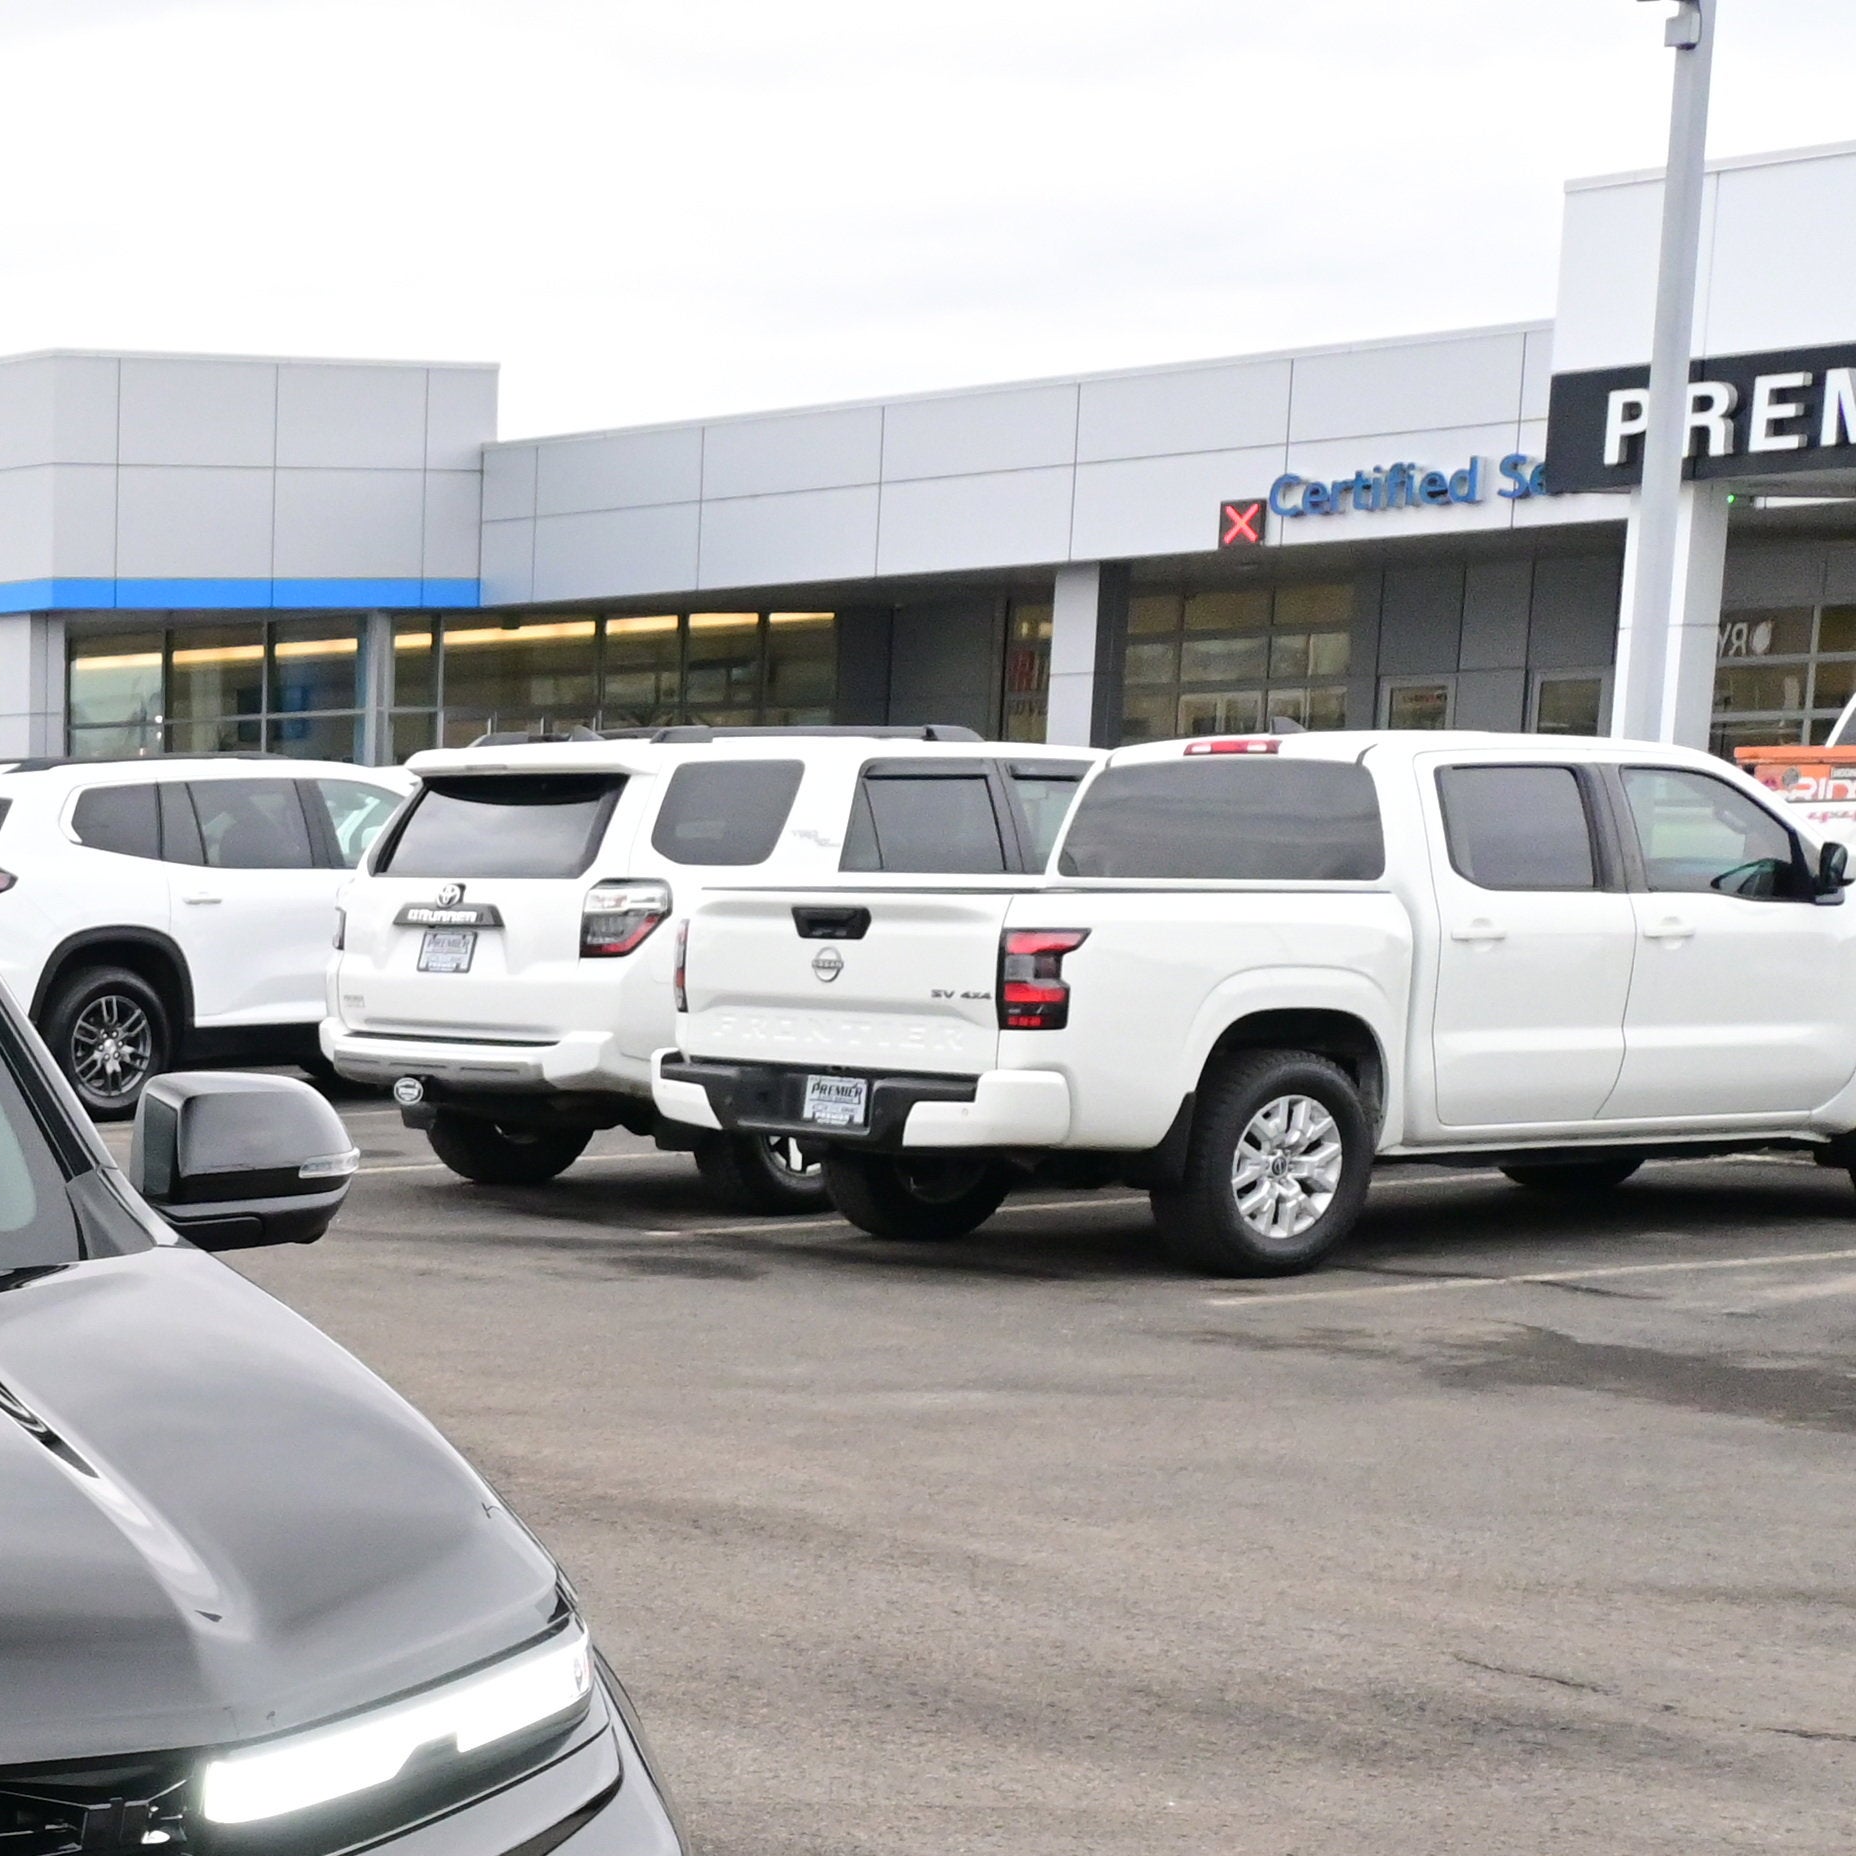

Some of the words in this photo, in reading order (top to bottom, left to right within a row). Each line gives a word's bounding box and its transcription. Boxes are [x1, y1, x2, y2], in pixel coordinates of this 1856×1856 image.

[1268, 455, 1485, 518] Certified
[931, 988, 955, 1000] SV
[811, 1081, 863, 1098] PREMIER
